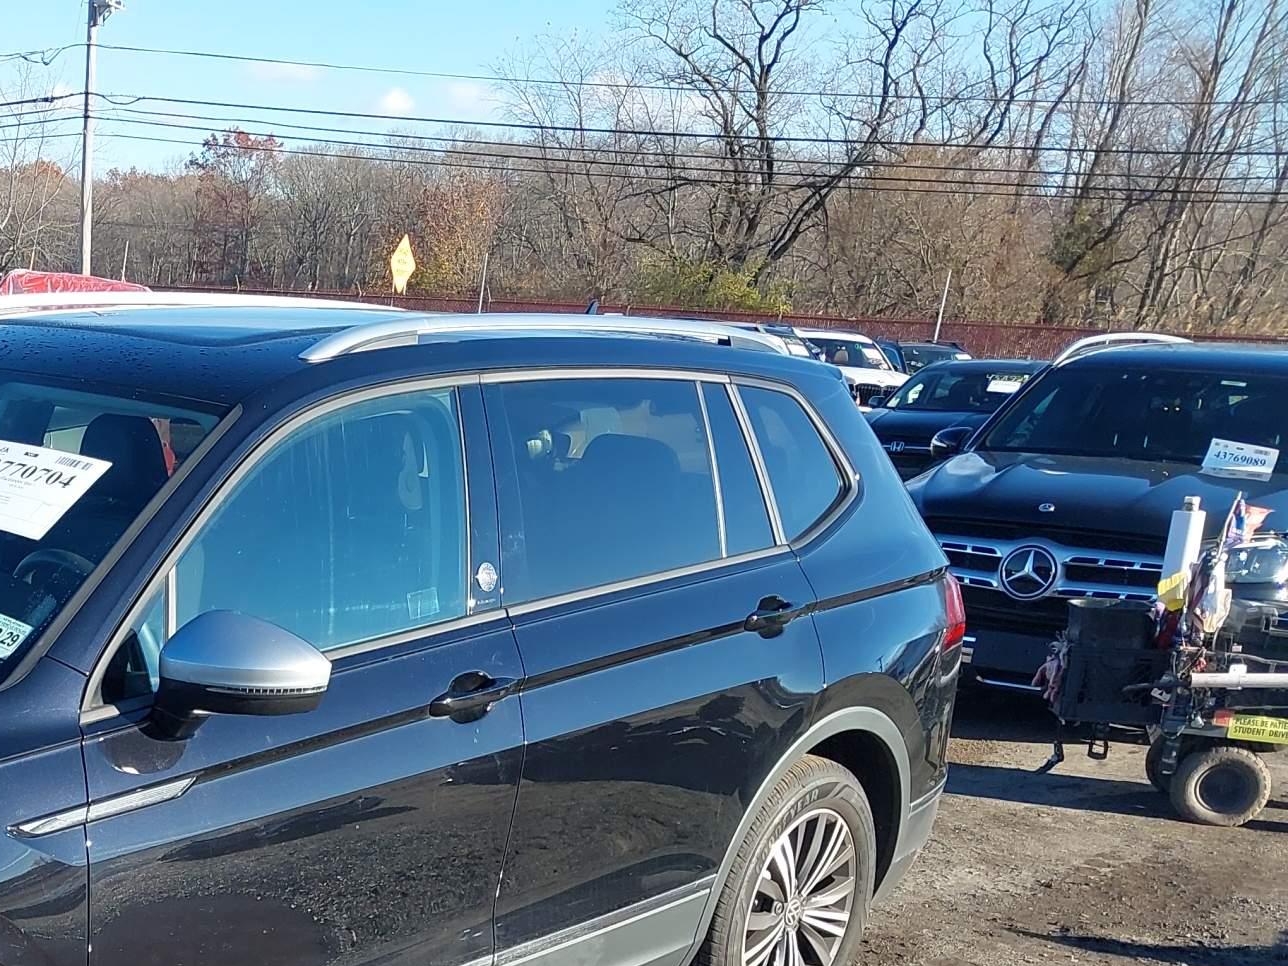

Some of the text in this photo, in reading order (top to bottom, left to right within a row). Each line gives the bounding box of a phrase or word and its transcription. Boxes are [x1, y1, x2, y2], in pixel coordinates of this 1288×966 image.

[1214, 449, 1267, 467] 43769089
[0, 631, 20, 647] 29
[1235, 717, 1260, 727] PLEASE
[1233, 726, 1266, 737] STUDENT
